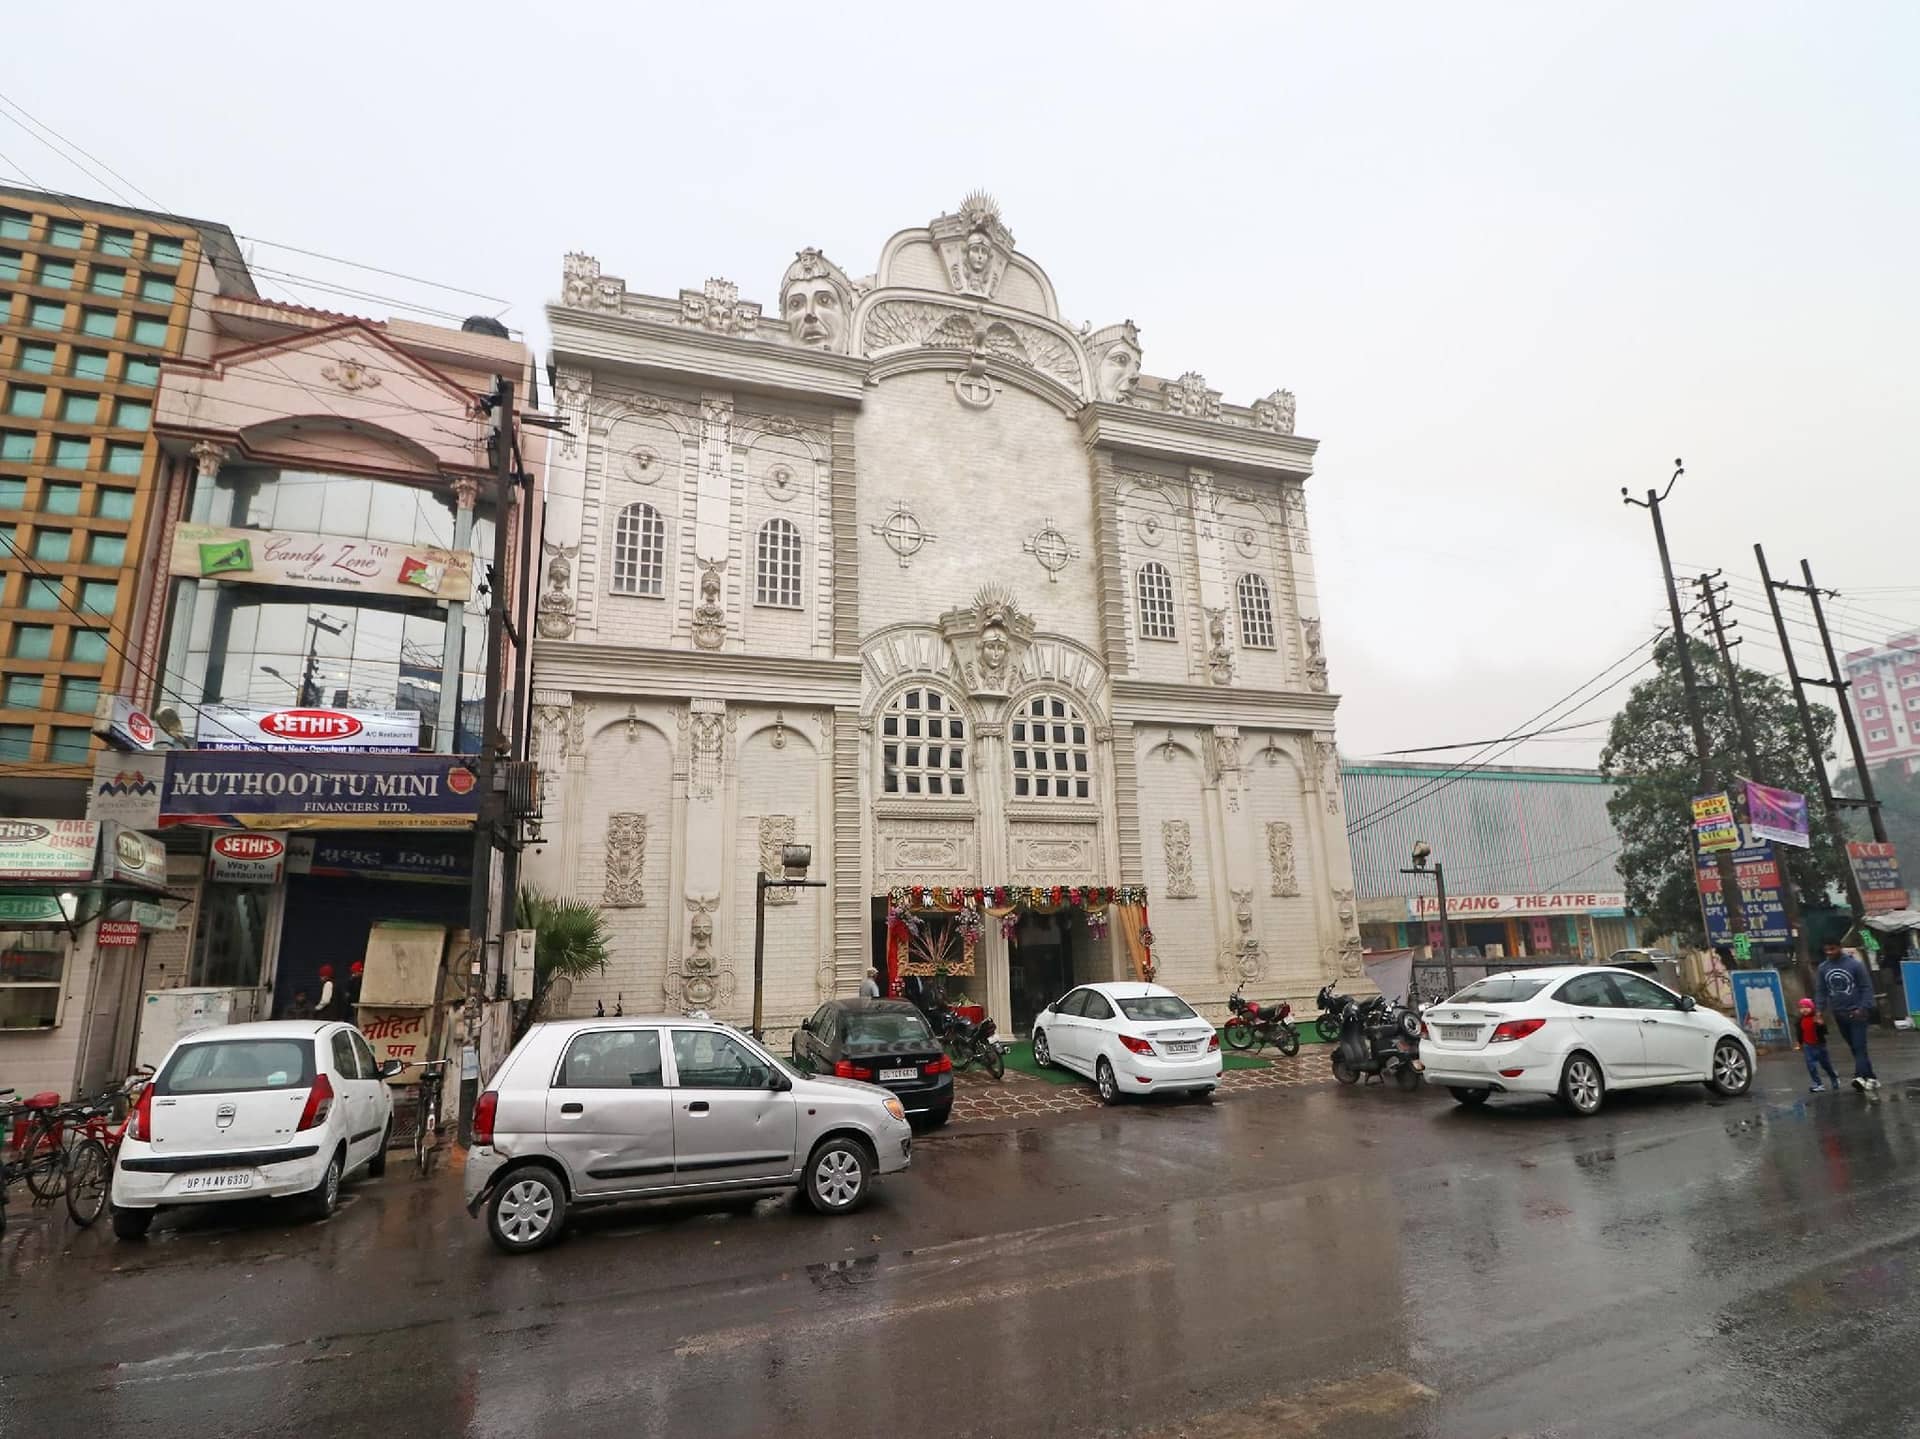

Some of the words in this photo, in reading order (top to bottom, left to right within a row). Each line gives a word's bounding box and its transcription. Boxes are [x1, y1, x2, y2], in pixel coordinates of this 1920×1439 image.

[264, 537, 325, 572] Candy
[331, 544, 381, 577] Zone
[370, 544, 389, 557] TM
[273, 712, 350, 734] SETHI'S
[215, 743, 241, 751] Model
[267, 744, 286, 752] East
[171, 771, 367, 798] MUTHOOTTU
[374, 774, 440, 798] MINI
[304, 802, 380, 812] FINANCIERS
[383, 802, 411, 812] LTD.
[56, 820, 95, 833] TAKE
[49, 834, 95, 848] AWAY
[223, 838, 275, 853] SETHI'S
[227, 861, 249, 871] Way
[253, 862, 265, 870] To
[1744, 862, 1775, 876] TYAGI
[216, 870, 273, 880] Restaurant
[1513, 894, 1596, 909] THEATRE
[1763, 903, 1784, 913] CMA
[102, 923, 138, 933] PACKING
[99, 935, 137, 945] COUNTER
[362, 1015, 424, 1040] मोहित
[386, 1044, 417, 1057] पान
[187, 1178, 200, 1189] UP
[201, 1177, 212, 1187] 14
[213, 1175, 226, 1187] AV
[227, 1174, 250, 1185] 6330
